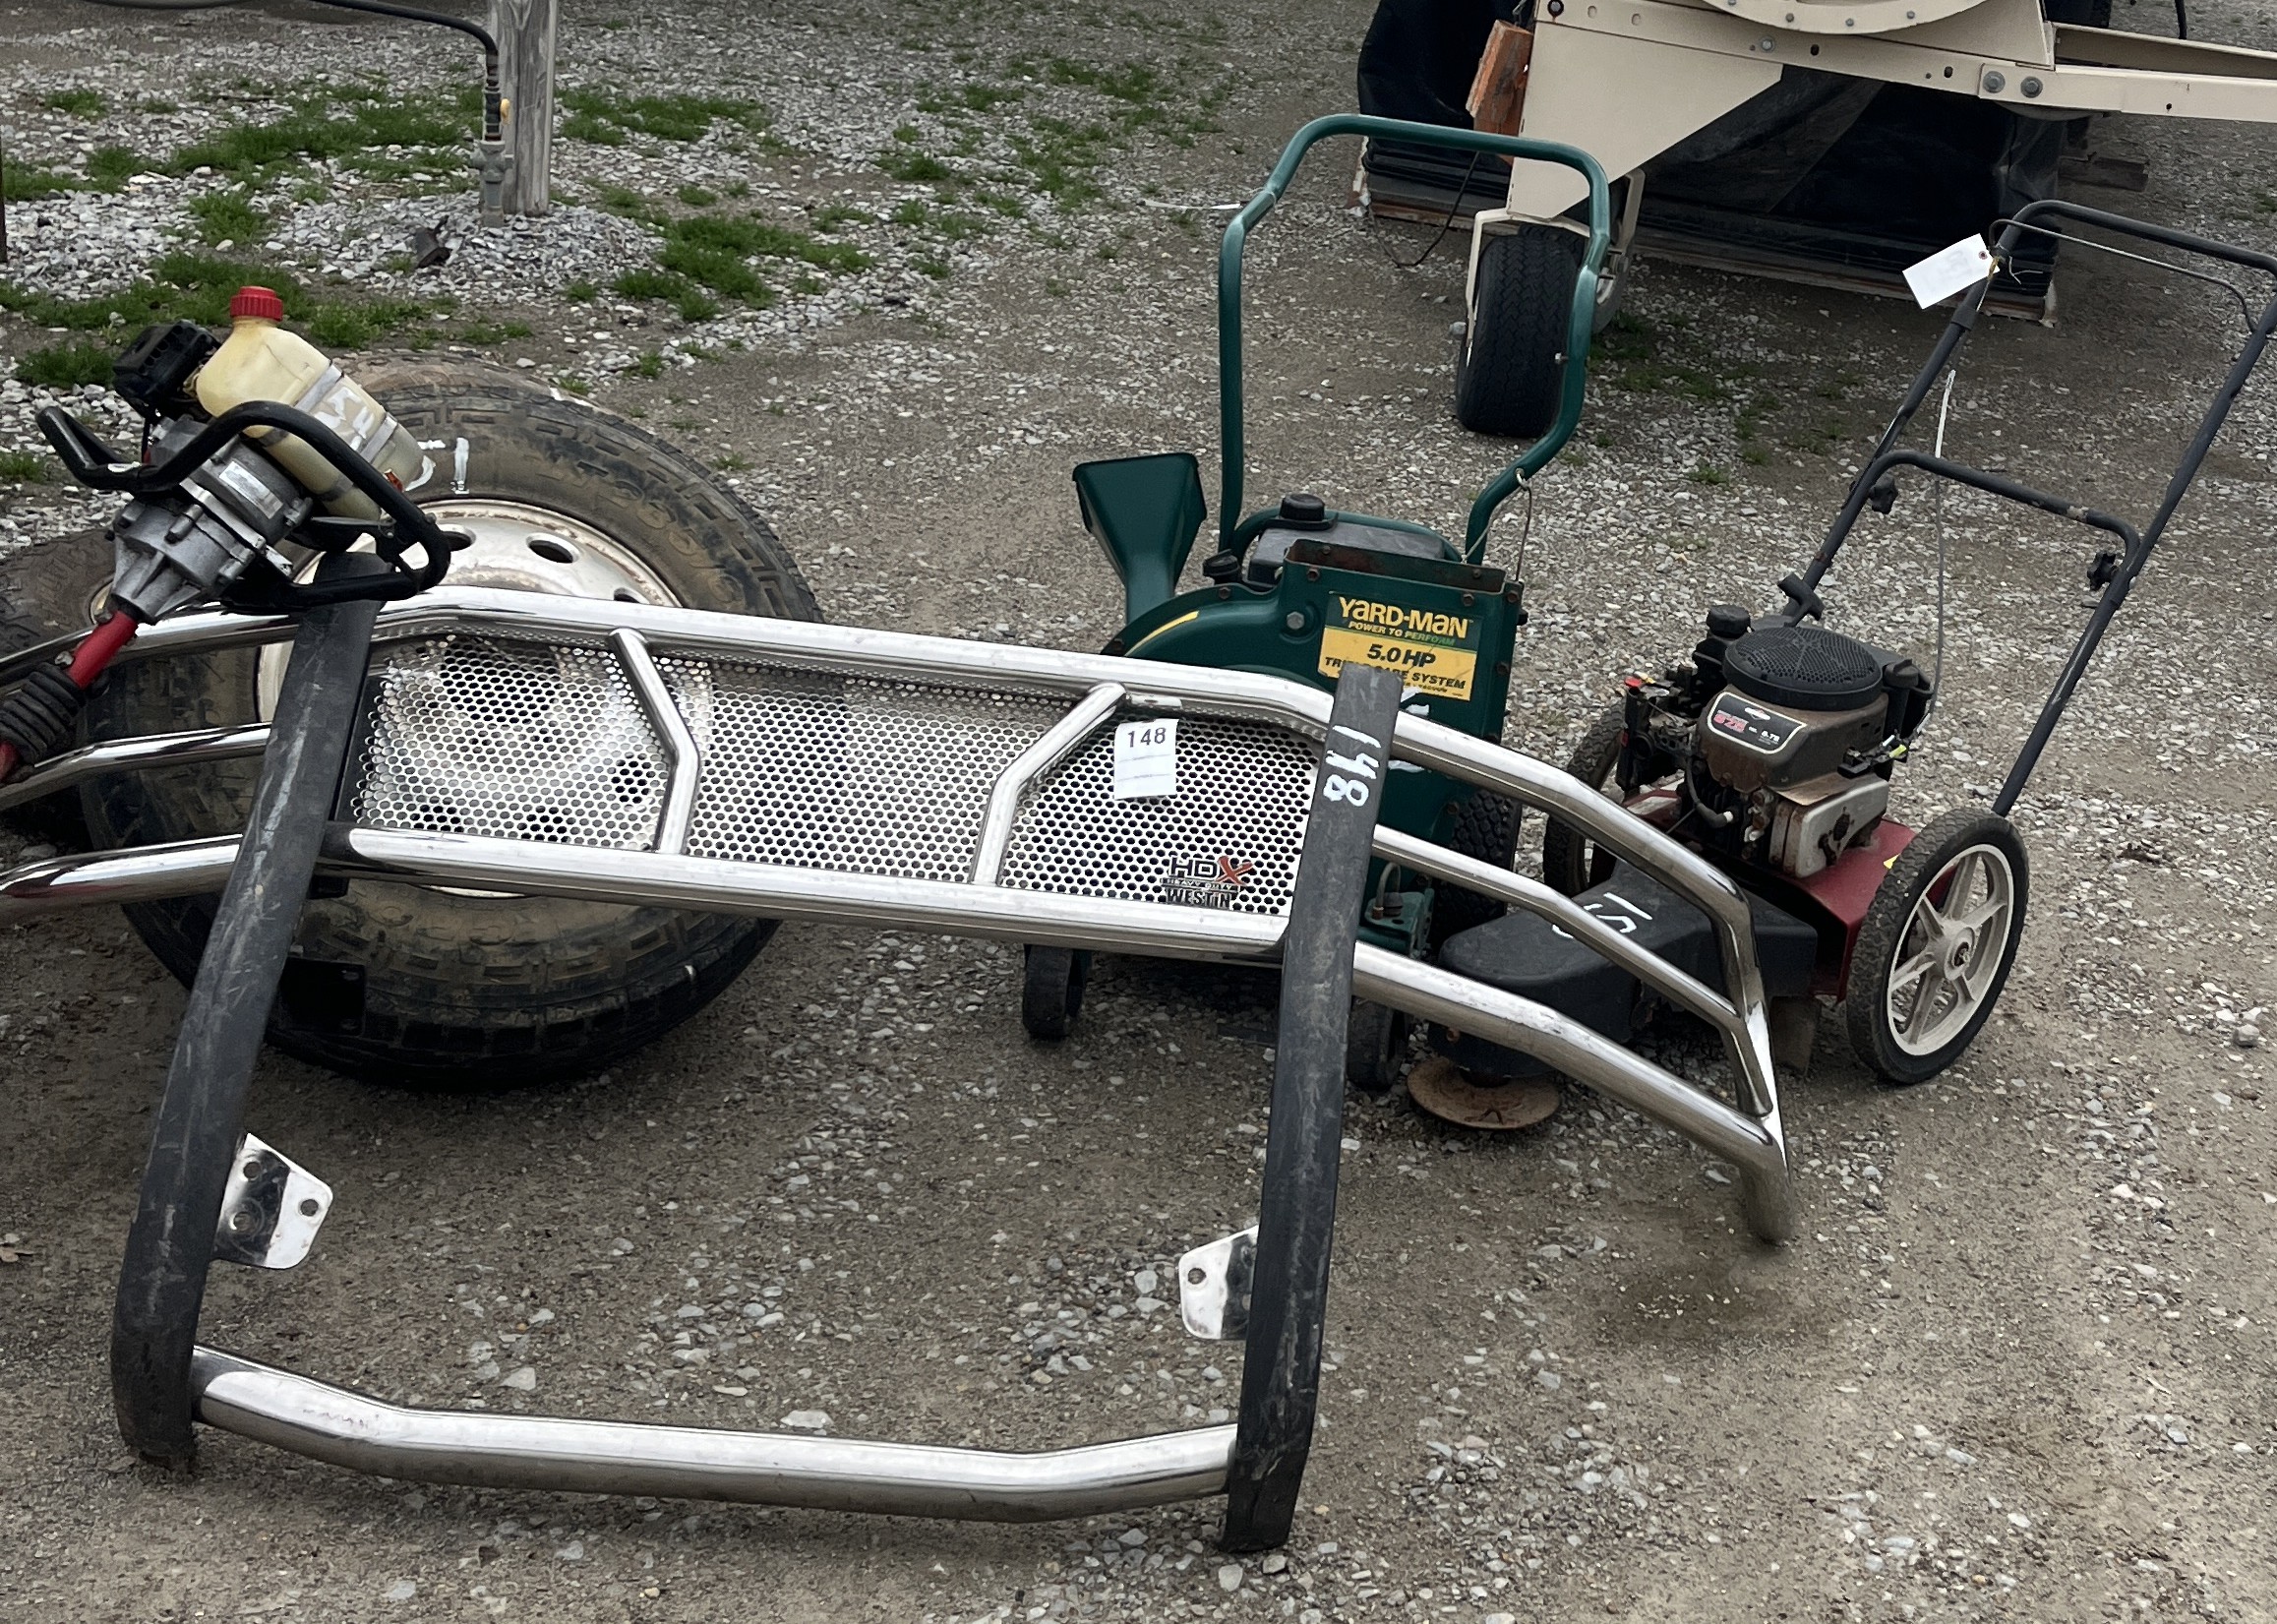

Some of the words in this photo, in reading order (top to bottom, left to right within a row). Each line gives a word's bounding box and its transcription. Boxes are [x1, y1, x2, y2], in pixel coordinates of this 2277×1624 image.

[1348, 621, 1386, 634] POWER
[1388, 627, 1402, 637] TO
[1367, 643, 1402, 663] 5.0
[1402, 650, 1437, 668] HP
[1411, 672, 1467, 690] SYSTEM
[1127, 727, 1167, 748] 148
[1323, 725, 1381, 807] 148
[1168, 855, 1254, 887] HDX
[1167, 887, 1230, 908] WESTIN
